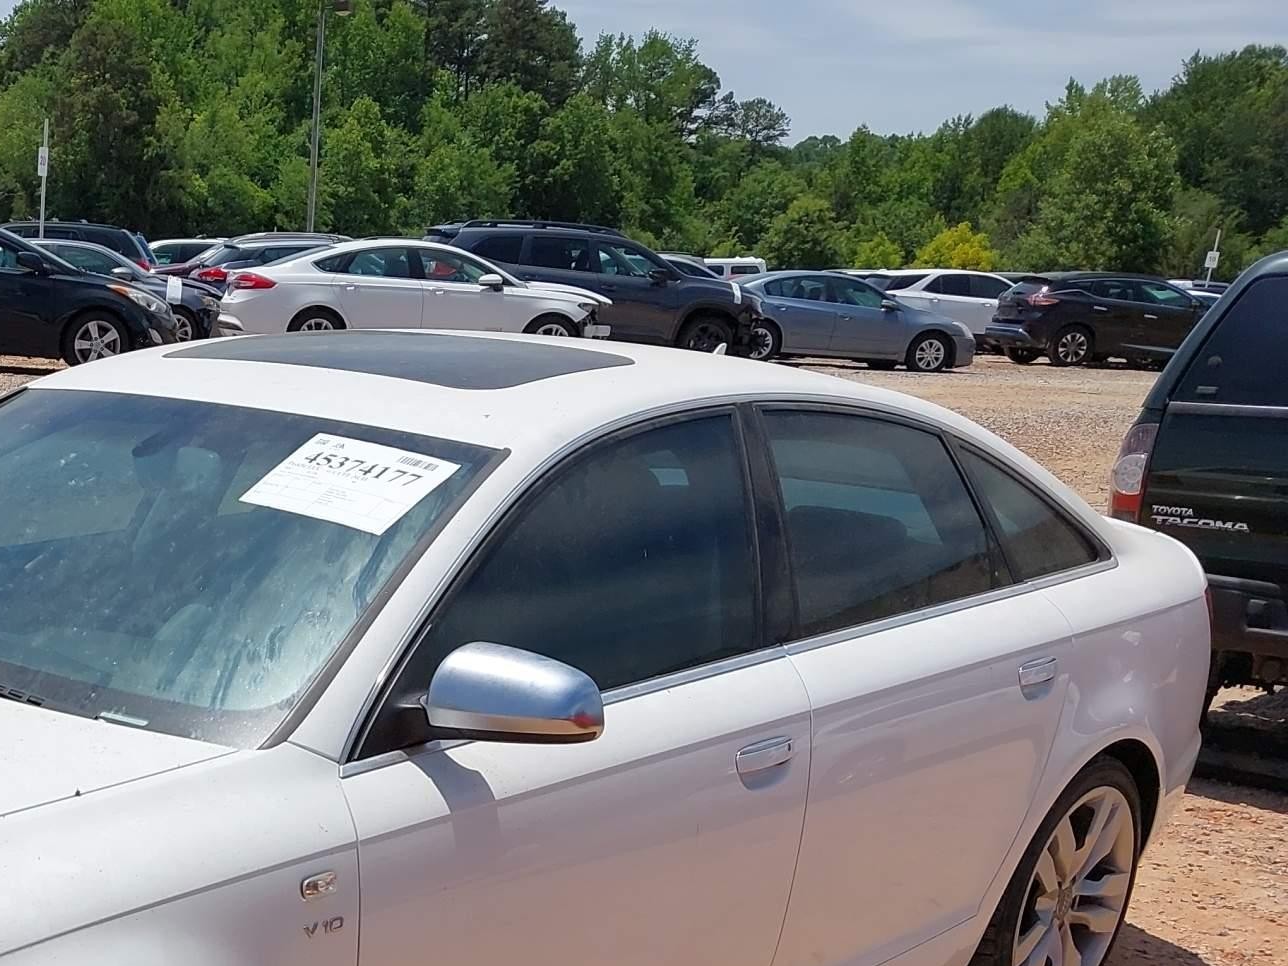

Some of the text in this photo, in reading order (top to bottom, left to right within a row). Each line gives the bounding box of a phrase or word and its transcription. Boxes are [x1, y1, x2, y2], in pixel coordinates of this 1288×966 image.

[304, 452, 423, 486] 45374177
[1152, 505, 1193, 516] TOYOTA
[1151, 515, 1249, 532] TACOMA
[303, 916, 344, 939] V10
